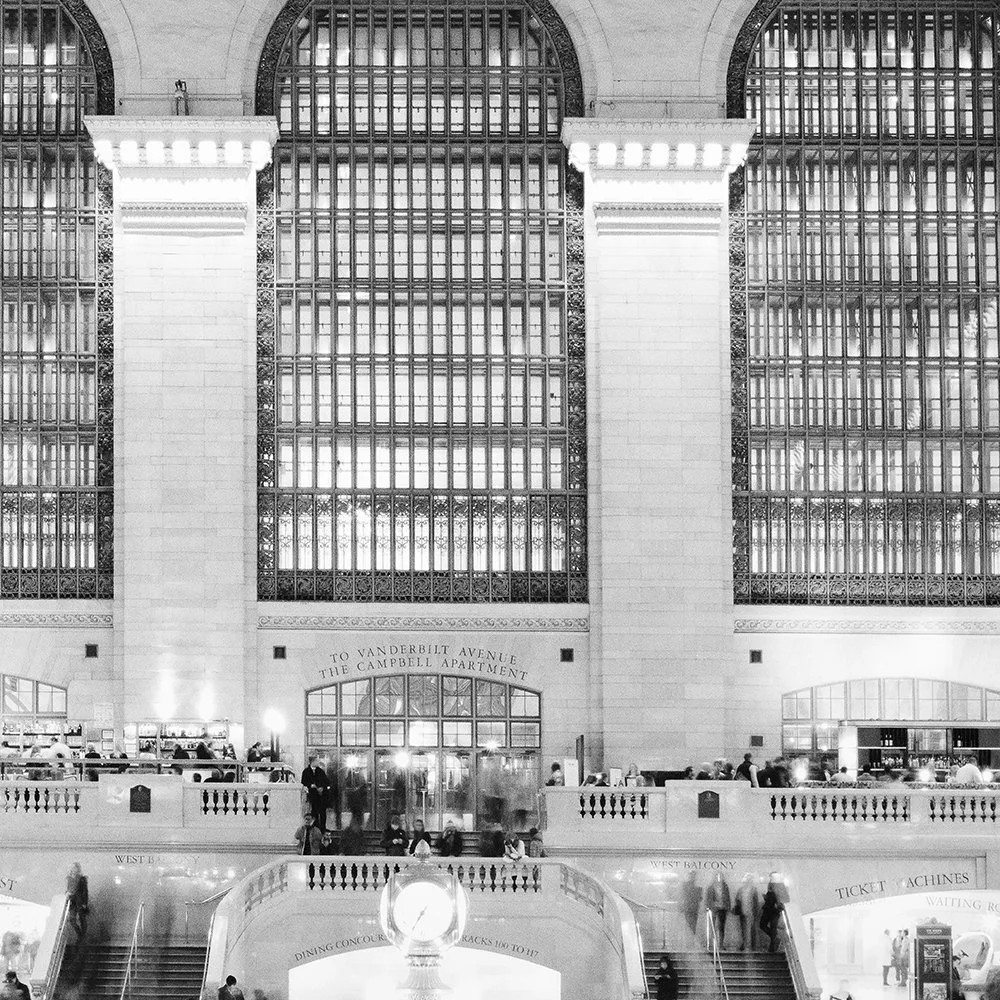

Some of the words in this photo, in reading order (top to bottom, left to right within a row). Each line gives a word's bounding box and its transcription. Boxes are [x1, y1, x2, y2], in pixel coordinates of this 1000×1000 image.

[330, 651, 349, 664] TO
[357, 644, 450, 658] VANDERBILT
[458, 647, 517, 666] AVENUE
[318, 665, 350, 680] THE
[356, 657, 432, 672] CAMPBELL
[441, 657, 528, 681] APARTMENT
[114, 855, 145, 864] WEST
[650, 860, 680, 868] WEST
[684, 861, 736, 870] BALCONY
[0, 878, 18, 892] ST
[835, 880, 886, 900] TICKET
[902, 872, 970, 889] ACHINES
[926, 896, 982, 910] WAITING
[294, 943, 334, 962] DINING
[335, 934, 387, 950] CONCOUR
[462, 934, 492, 948] RACKS
[495, 939, 509, 950] 100
[512, 944, 525, 954] TO
[526, 948, 540, 958] 117
